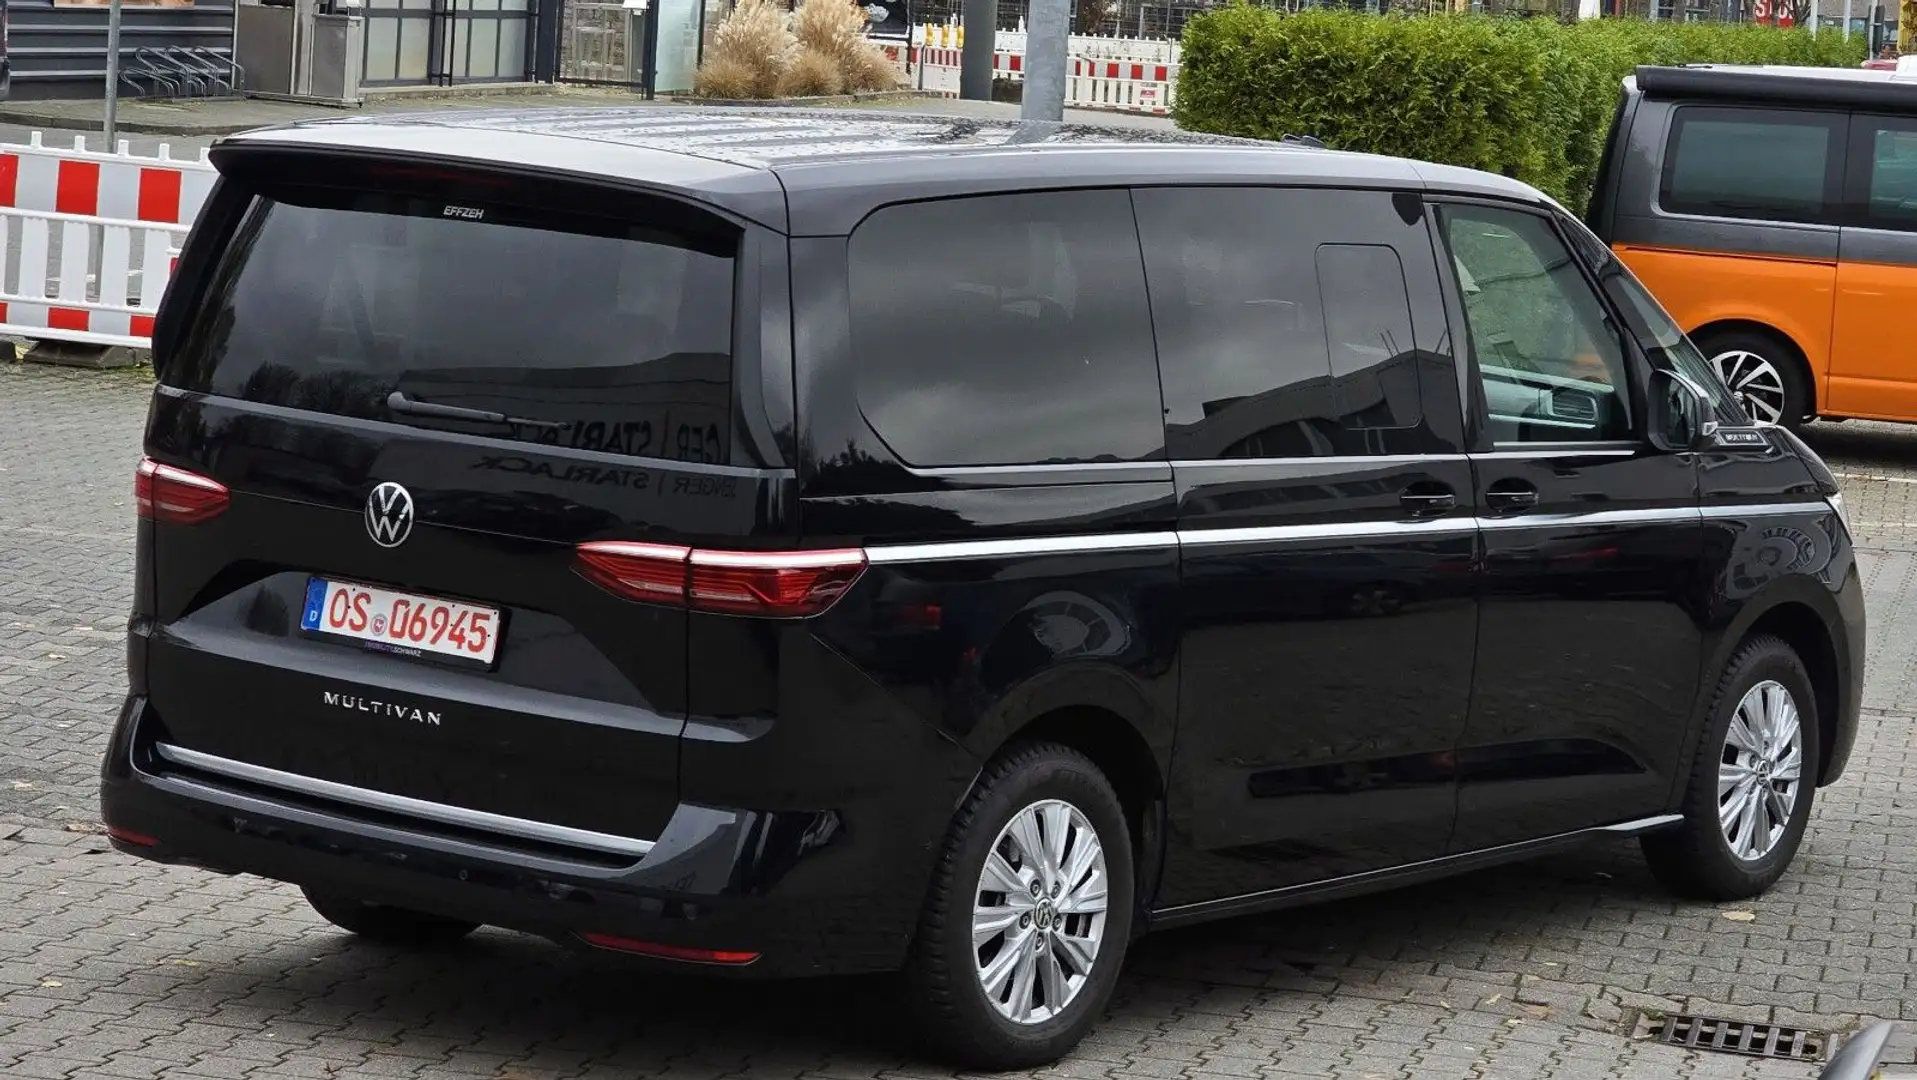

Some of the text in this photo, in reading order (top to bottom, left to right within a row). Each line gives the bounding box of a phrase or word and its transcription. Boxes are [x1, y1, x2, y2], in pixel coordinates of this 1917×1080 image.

[443, 205, 485, 219] EFFZEH
[309, 610, 318, 622] D
[329, 588, 491, 653] OS 06945
[324, 691, 441, 726] MULTIVAN
